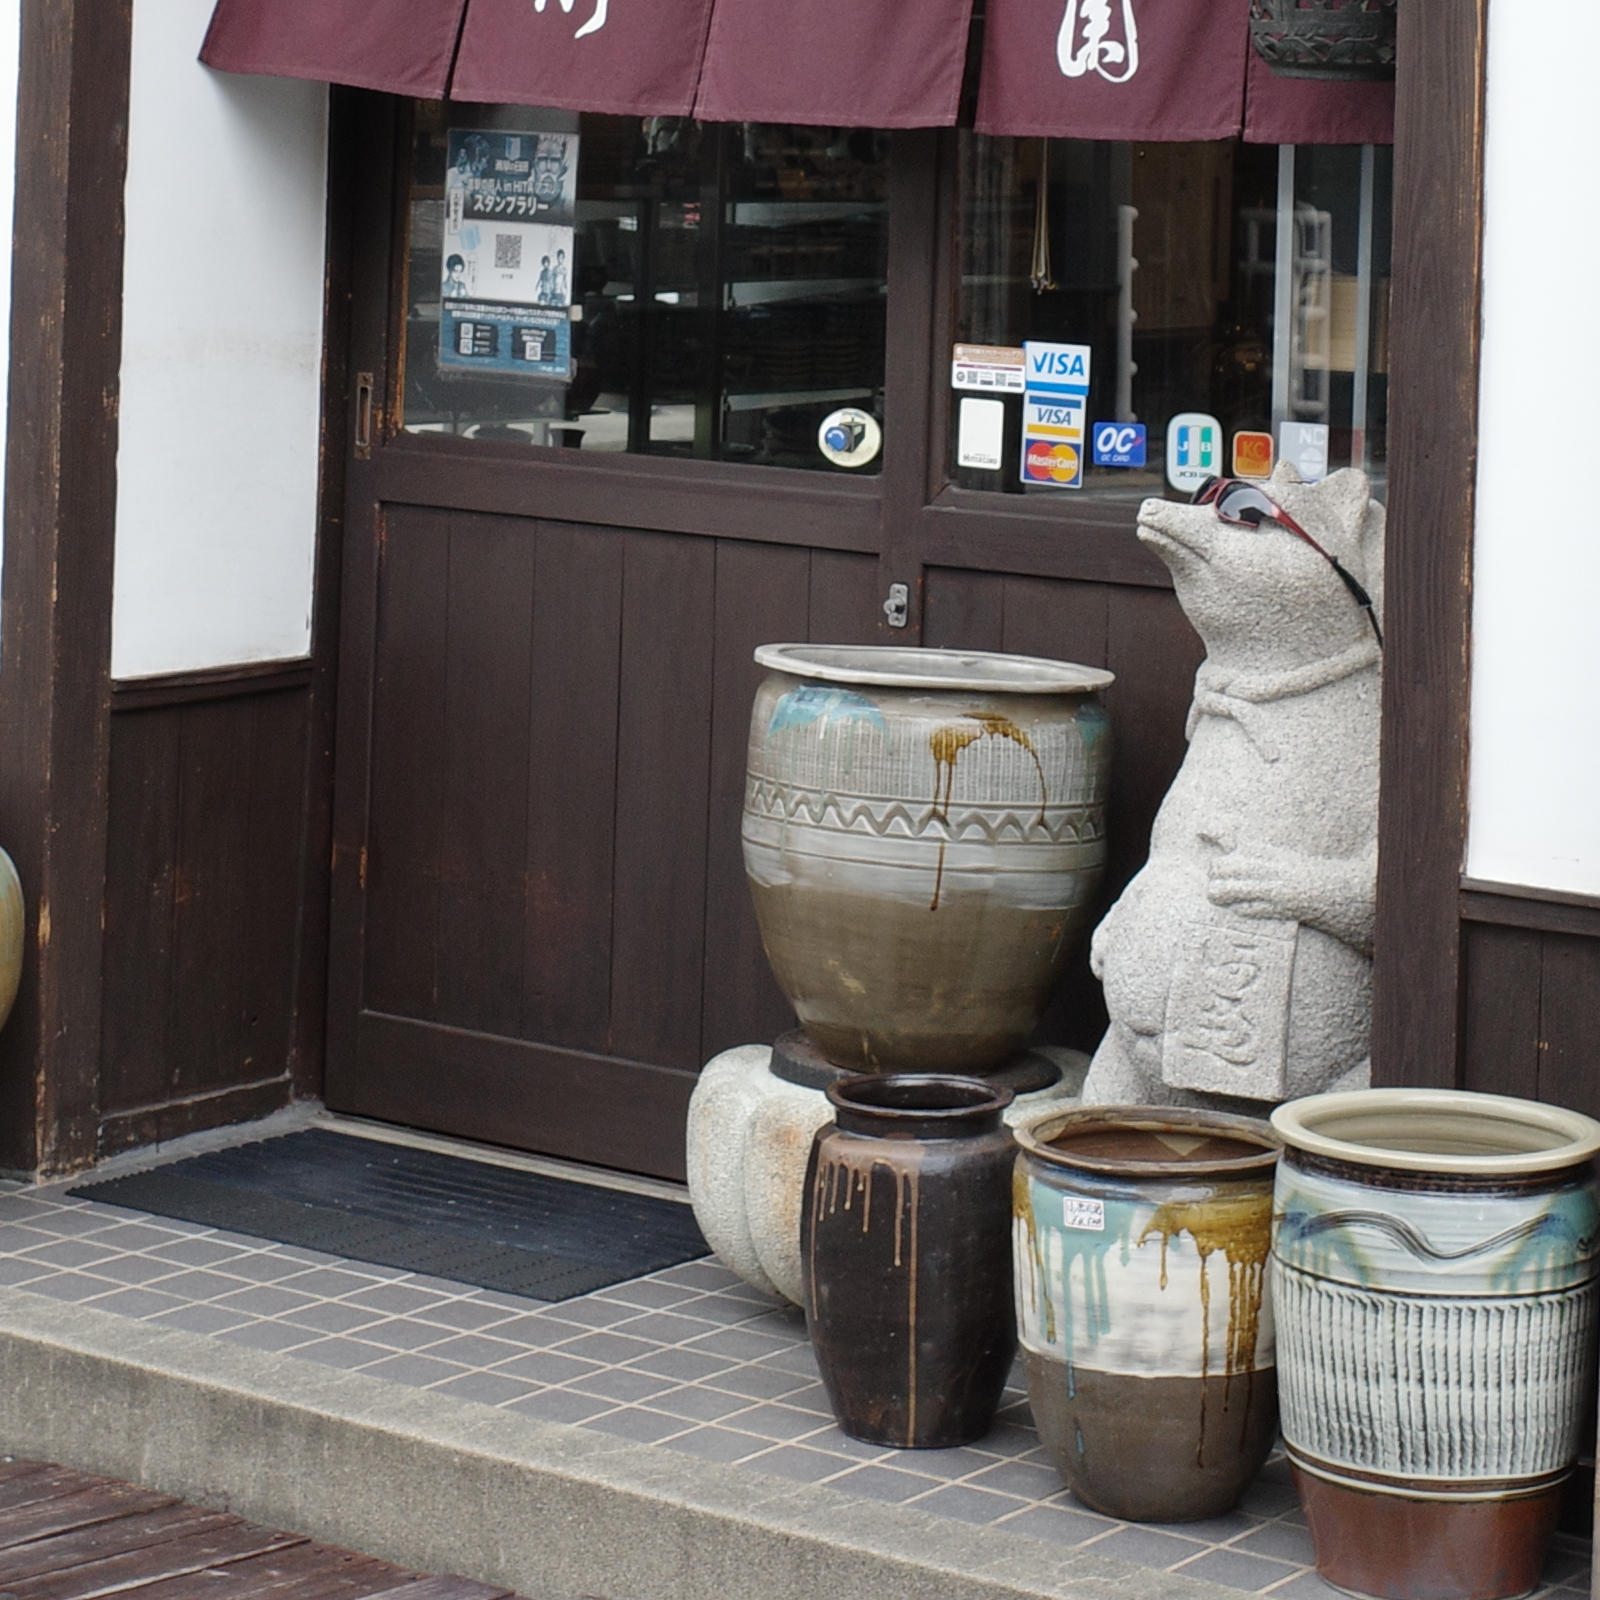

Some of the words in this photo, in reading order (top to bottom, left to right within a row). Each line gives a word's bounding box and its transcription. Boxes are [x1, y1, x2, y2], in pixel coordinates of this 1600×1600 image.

[1033, 352, 1085, 377] VISA
[1037, 408, 1072, 426] VISA
[1097, 426, 1137, 454] OC
[1243, 441, 1265, 458] KC
[1027, 453, 1078, 470] MasterCard
